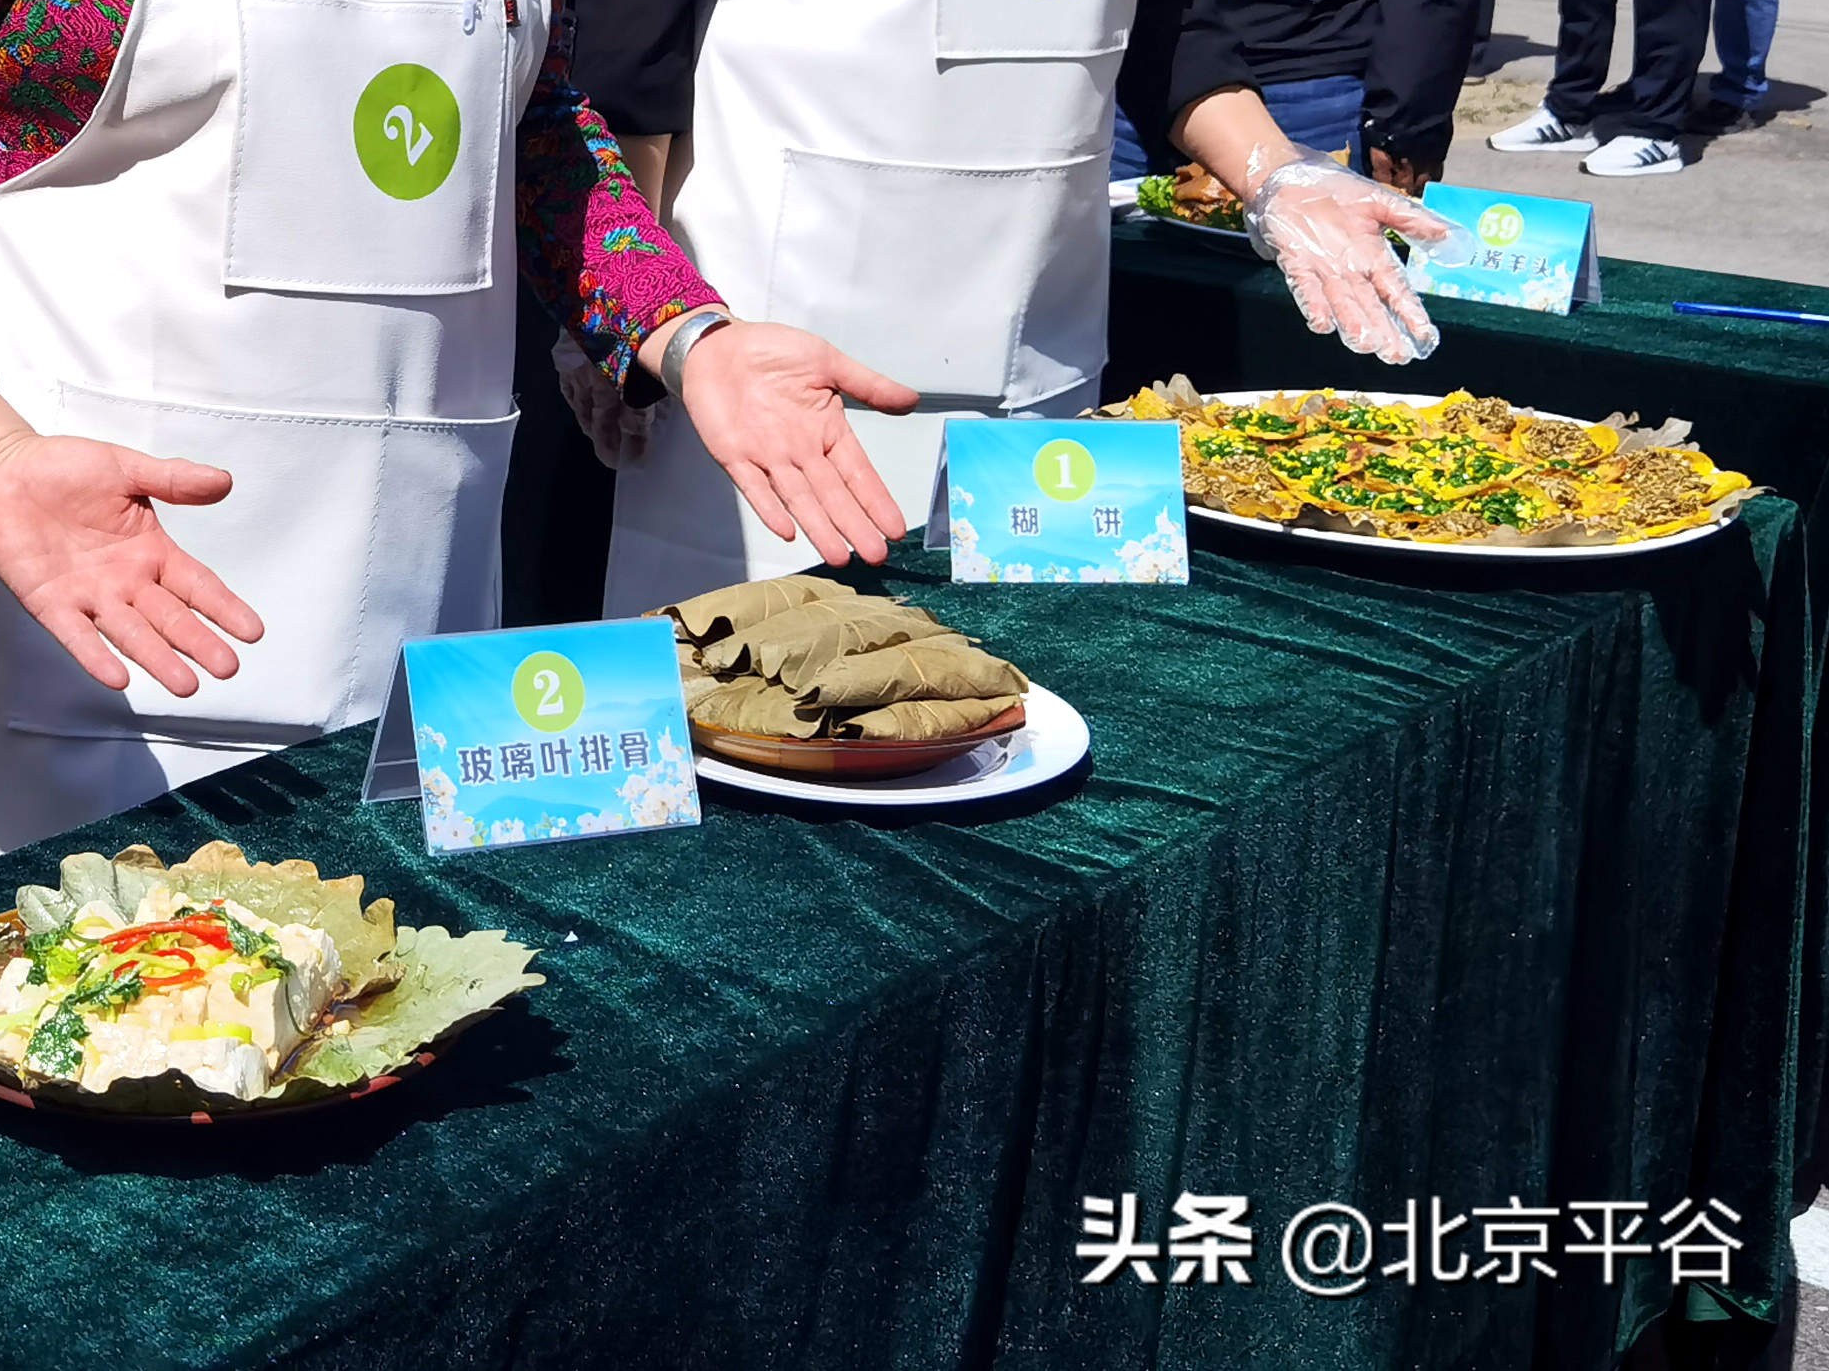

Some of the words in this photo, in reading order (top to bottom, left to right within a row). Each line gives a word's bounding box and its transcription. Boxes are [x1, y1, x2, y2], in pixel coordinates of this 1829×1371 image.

[383, 104, 435, 167] 2
[1482, 213, 1520, 241] 59
[1054, 453, 1077, 489] 1
[532, 669, 565, 717] 2
[457, 731, 650, 786] 玻璃叶排骨
